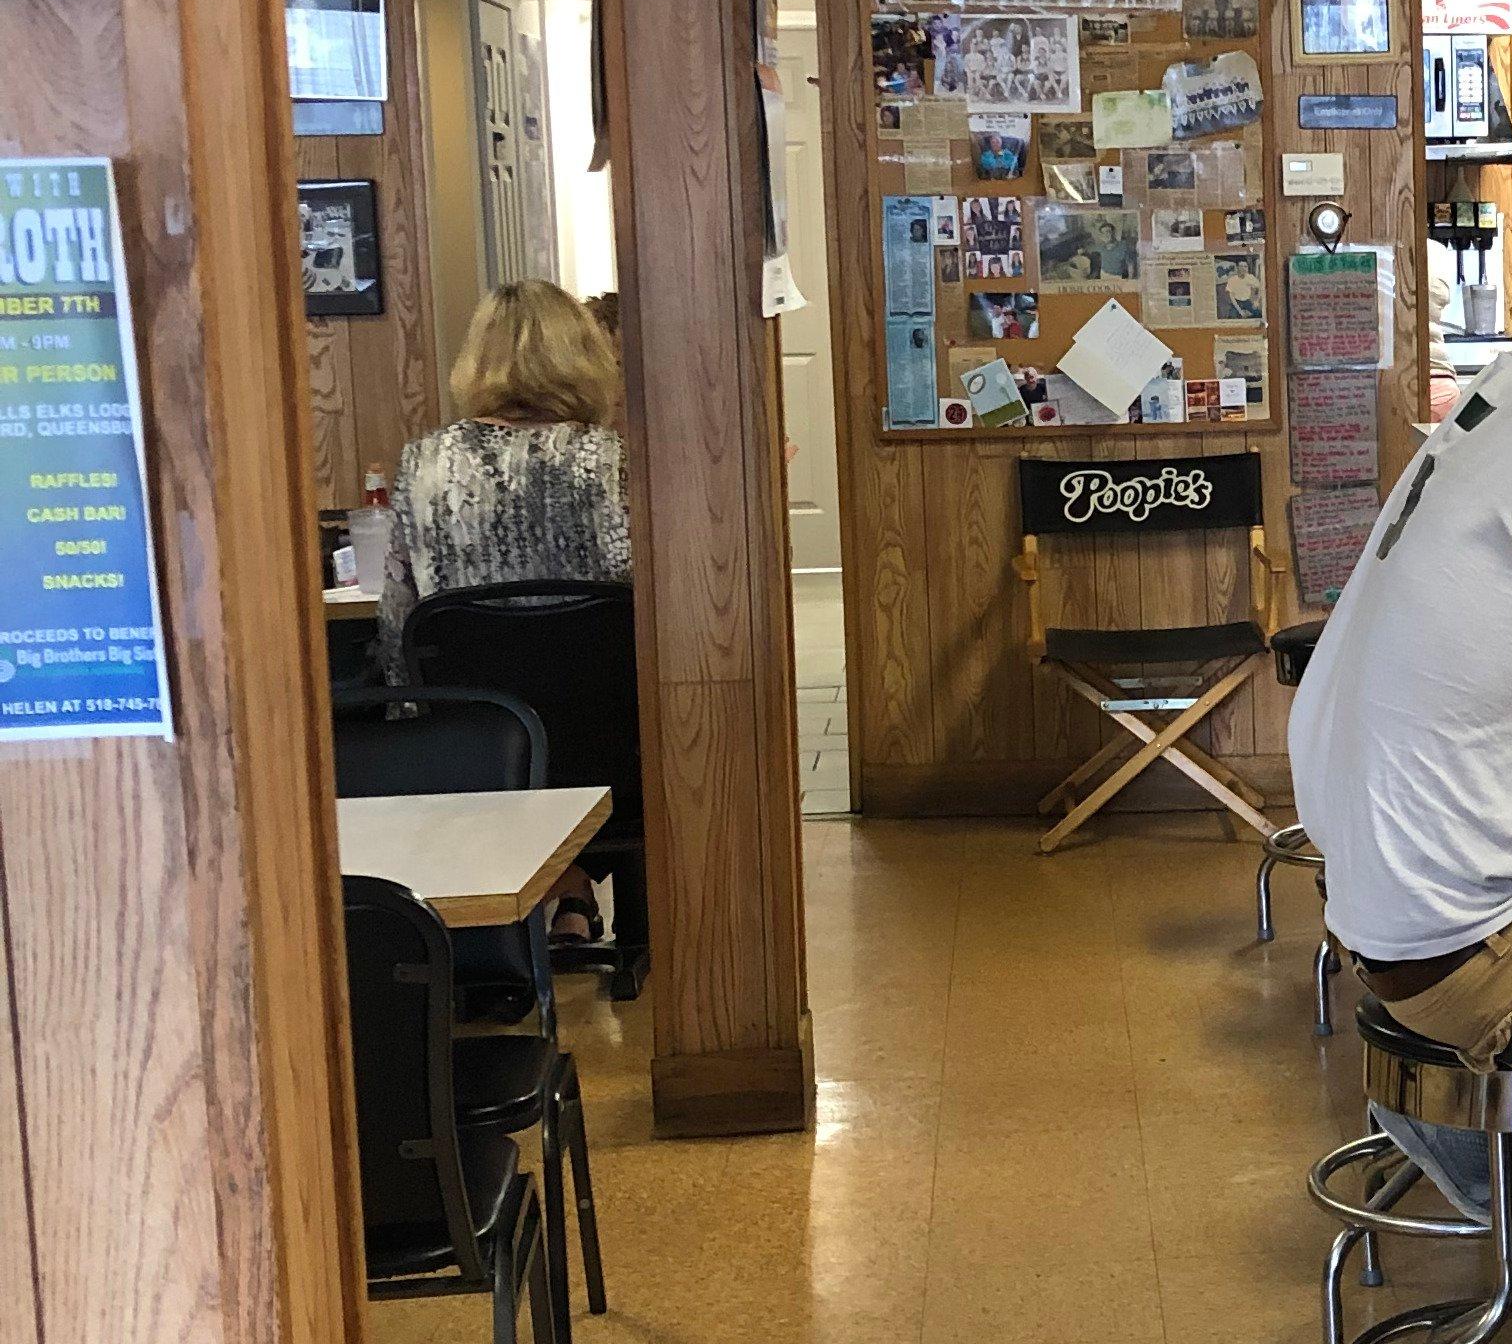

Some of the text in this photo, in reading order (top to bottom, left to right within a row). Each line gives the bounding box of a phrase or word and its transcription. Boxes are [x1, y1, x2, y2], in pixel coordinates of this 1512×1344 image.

[61, 296, 100, 314] 7TH
[26, 363, 116, 383] PERSON
[36, 404, 83, 418] ELKS
[1060, 467, 1213, 523] Poopie's
[27, 507, 78, 523] CASH
[43, 573, 124, 589] SNACKS!
[82, 626, 105, 641] TO
[16, 649, 42, 668] Big
[44, 647, 106, 664] Brothers
[108, 645, 132, 665] Big
[2, 700, 58, 715] HELEN
[61, 699, 81, 712] AT
